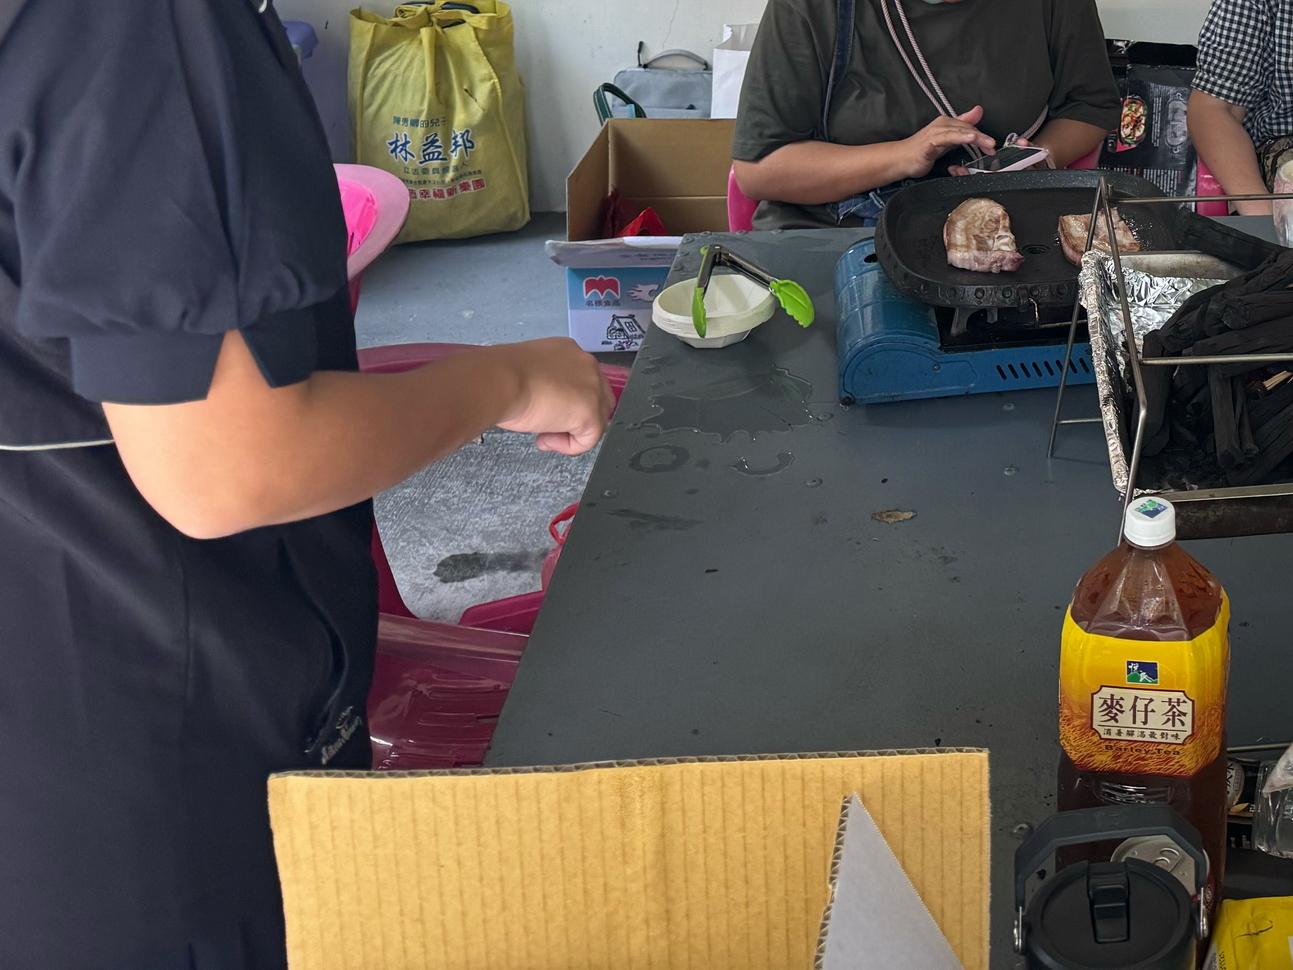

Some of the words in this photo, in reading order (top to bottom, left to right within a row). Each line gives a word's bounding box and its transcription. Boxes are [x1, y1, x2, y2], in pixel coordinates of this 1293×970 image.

[387, 128, 476, 166] 林益邦
[1098, 693, 1188, 728] 麥仔茶
[1103, 727, 1181, 741] 消暑解渴最對味
[1105, 744, 1151, 755] Barley
[1155, 748, 1181, 756] Tea
